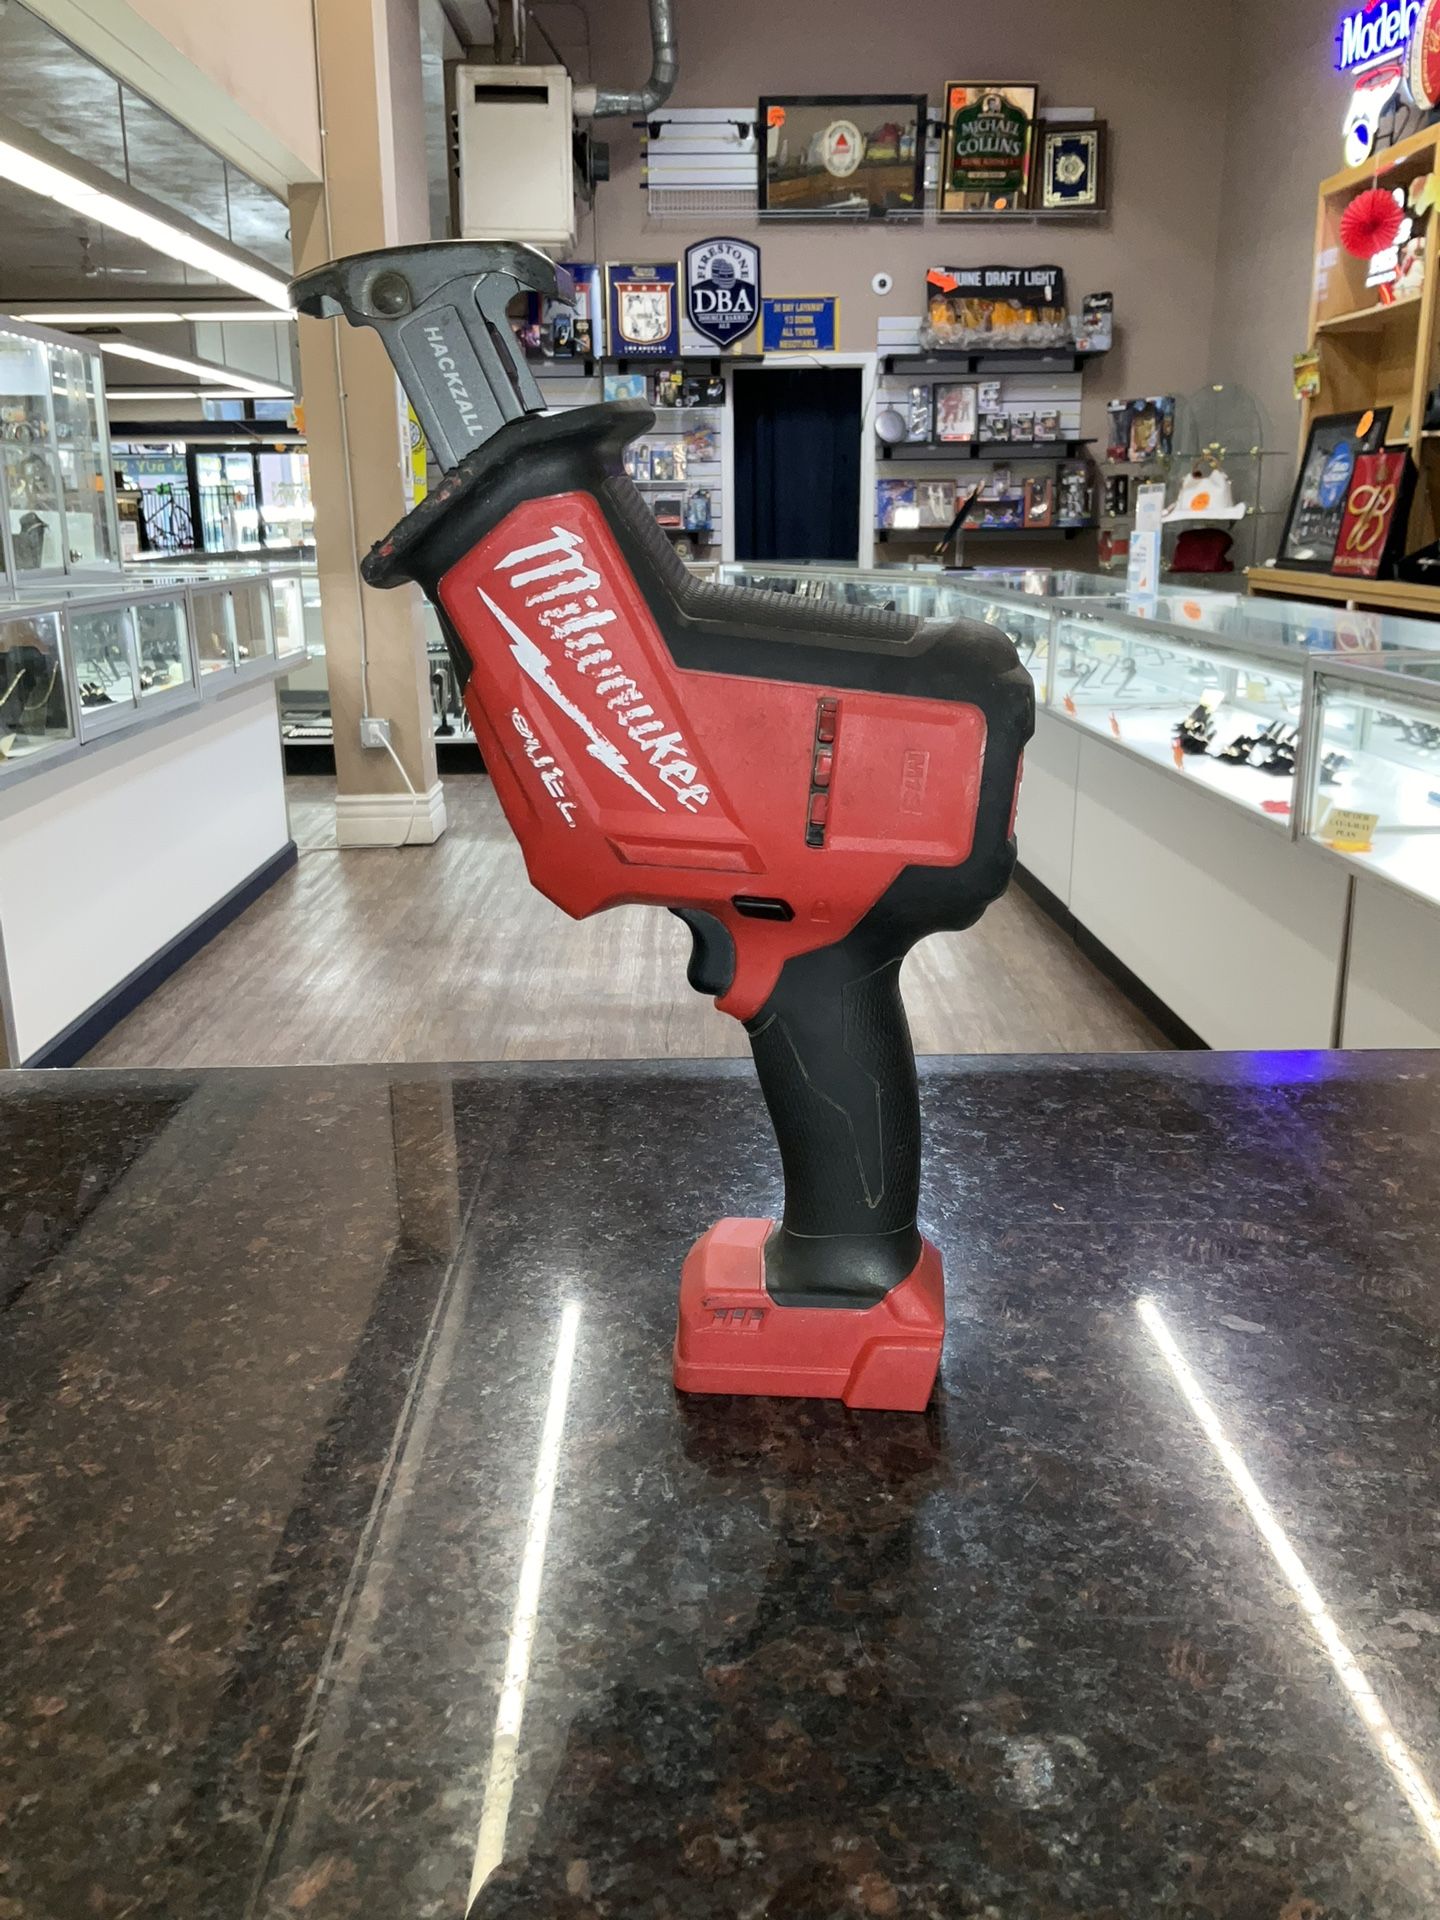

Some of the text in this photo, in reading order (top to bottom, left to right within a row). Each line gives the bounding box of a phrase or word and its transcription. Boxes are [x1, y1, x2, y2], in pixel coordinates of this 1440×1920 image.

[961, 119, 1020, 137] MICHAEL
[956, 137, 1022, 156] COLLINS
[697, 243, 749, 279] FIRESTONE
[985, 271, 1020, 287] DRAFT
[1024, 271, 1057, 286] LIGHT
[693, 288, 754, 313] DBA
[423, 326, 484, 437] HACKZALL
[494, 526, 710, 813] Milwaukee
